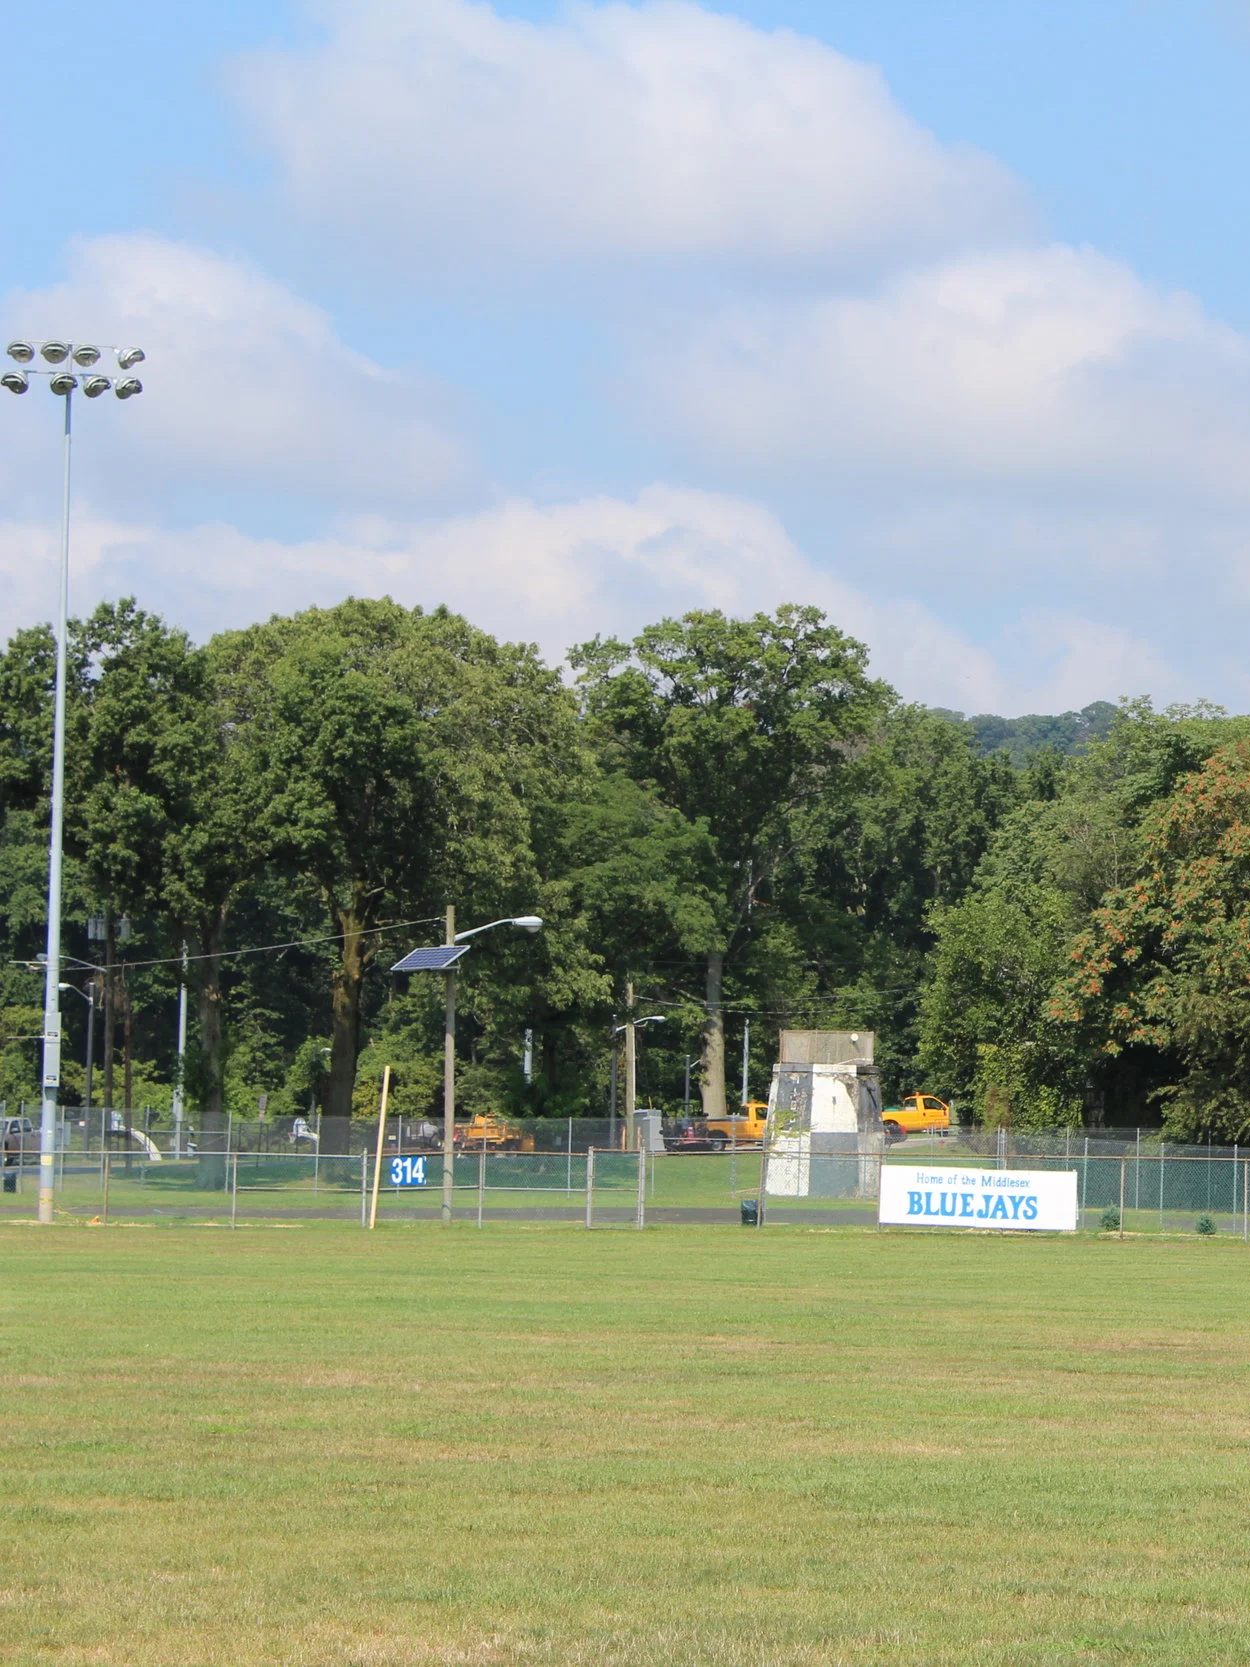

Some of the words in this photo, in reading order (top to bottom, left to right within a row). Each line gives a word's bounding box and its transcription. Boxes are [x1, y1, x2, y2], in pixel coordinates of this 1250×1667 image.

[391, 1157, 425, 1184] 314
[916, 1172, 944, 1185] Home
[947, 1174, 958, 1185] of
[961, 1175, 977, 1186] the
[981, 1175, 1030, 1188] Middlesex
